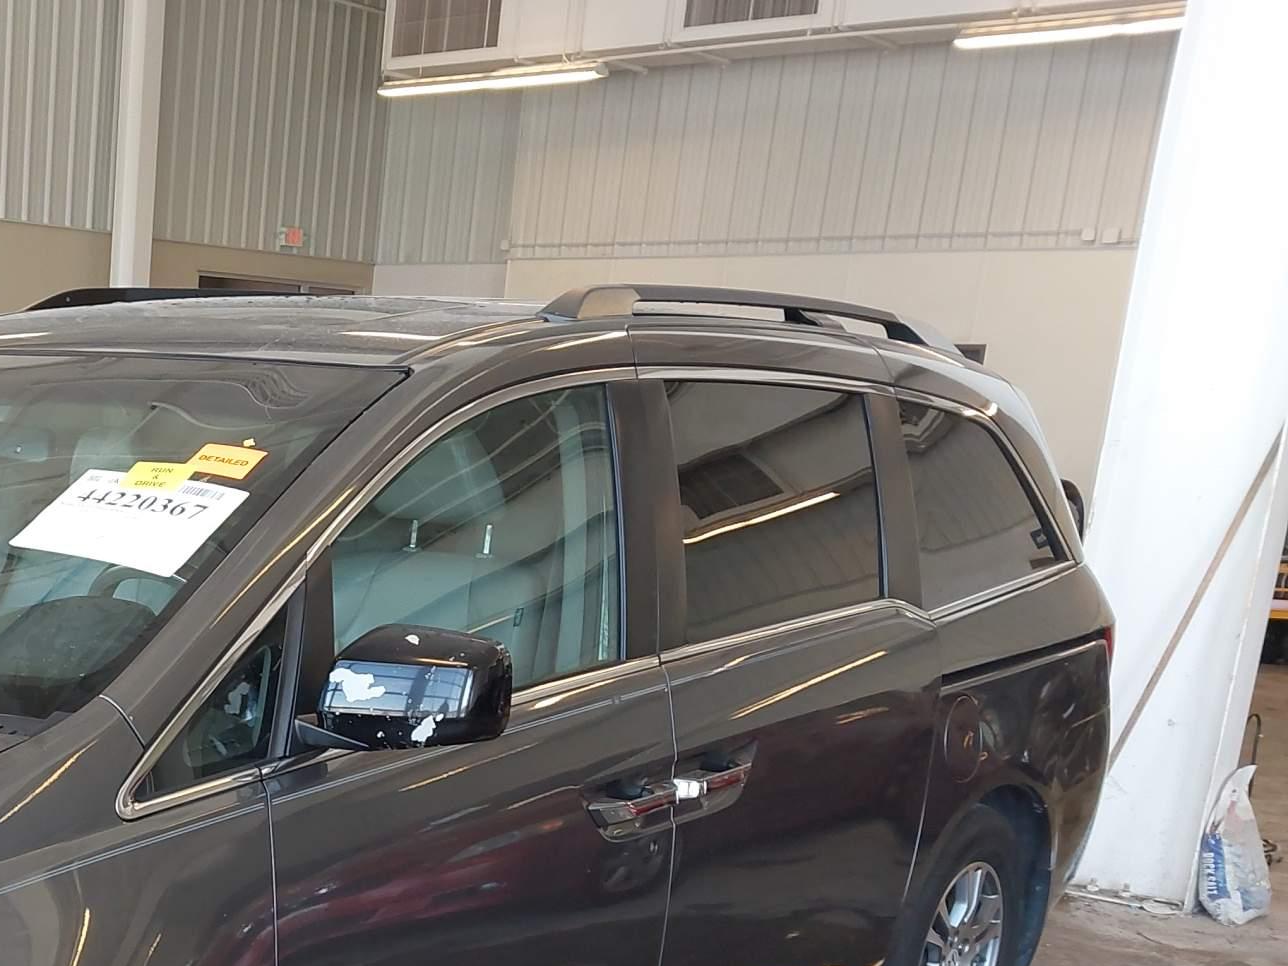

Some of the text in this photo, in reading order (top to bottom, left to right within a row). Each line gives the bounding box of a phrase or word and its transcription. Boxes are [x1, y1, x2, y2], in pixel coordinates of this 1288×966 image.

[198, 453, 250, 468] DETAILED
[151, 466, 175, 474] RUN
[134, 480, 167, 489] DRIVE
[76, 488, 209, 520] 44220367
